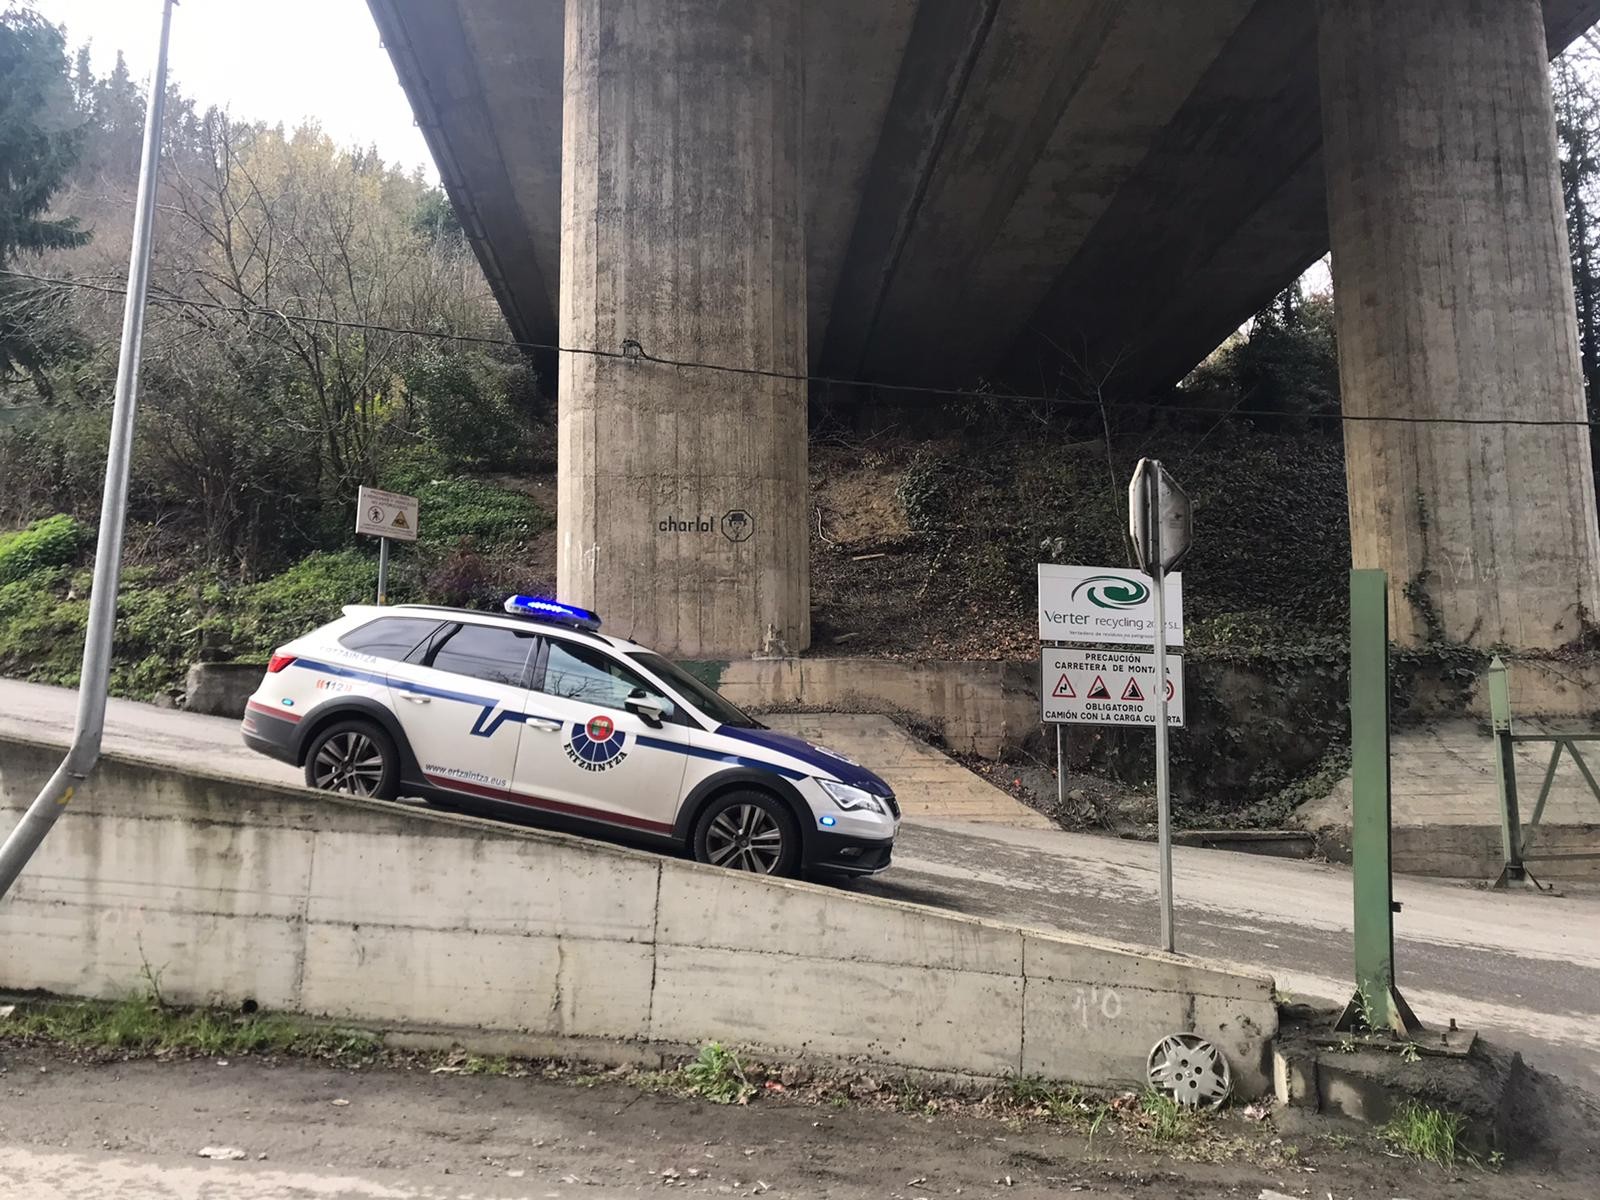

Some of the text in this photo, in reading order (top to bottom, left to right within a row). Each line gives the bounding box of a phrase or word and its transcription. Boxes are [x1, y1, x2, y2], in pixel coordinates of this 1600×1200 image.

[1044, 610, 1090, 625] Verter
[1095, 617, 1144, 630] recycling
[1085, 653, 1141, 663] PRECAUCIÓN
[1055, 661, 1170, 674] CARRETERA DE MONTA
[1085, 702, 1144, 713] OBLIGATORIO
[1045, 709, 1181, 723] CAMIÓN CON LA CARGA CURTA
[563, 742, 628, 772] ERTZAINTZA
[425, 763, 506, 786] www.ertzaintza.eus
